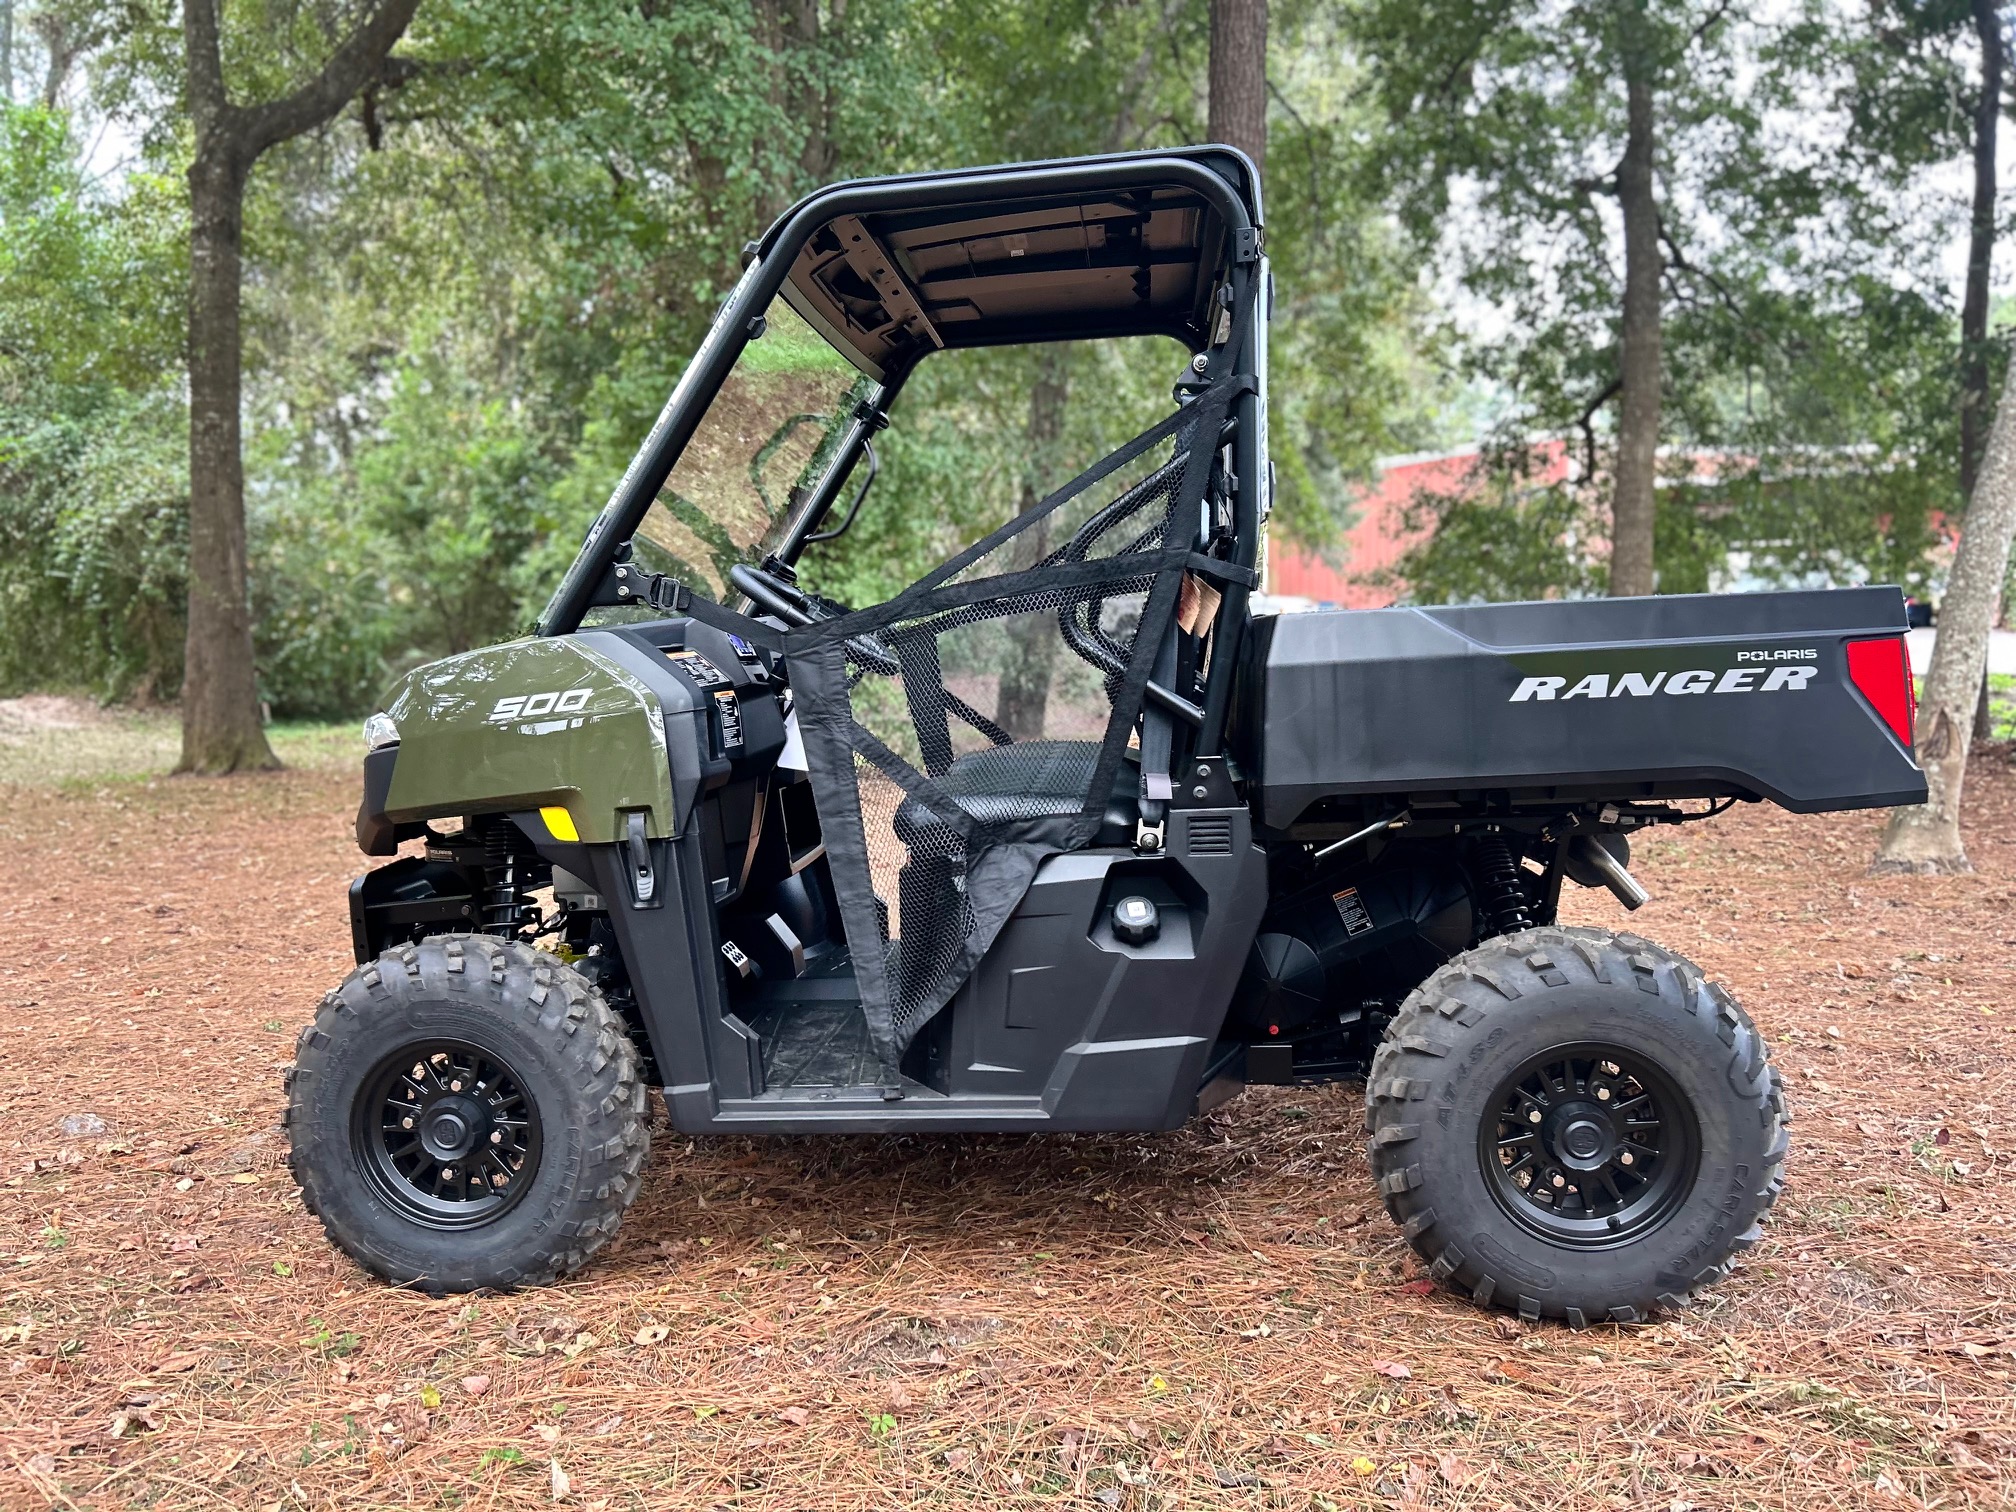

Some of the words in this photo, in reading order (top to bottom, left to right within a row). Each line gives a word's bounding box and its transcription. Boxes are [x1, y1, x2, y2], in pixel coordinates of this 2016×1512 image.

[1737, 648, 1818, 662] POLARIS
[1508, 665, 1819, 702] RANGER
[488, 687, 594, 721] 500
